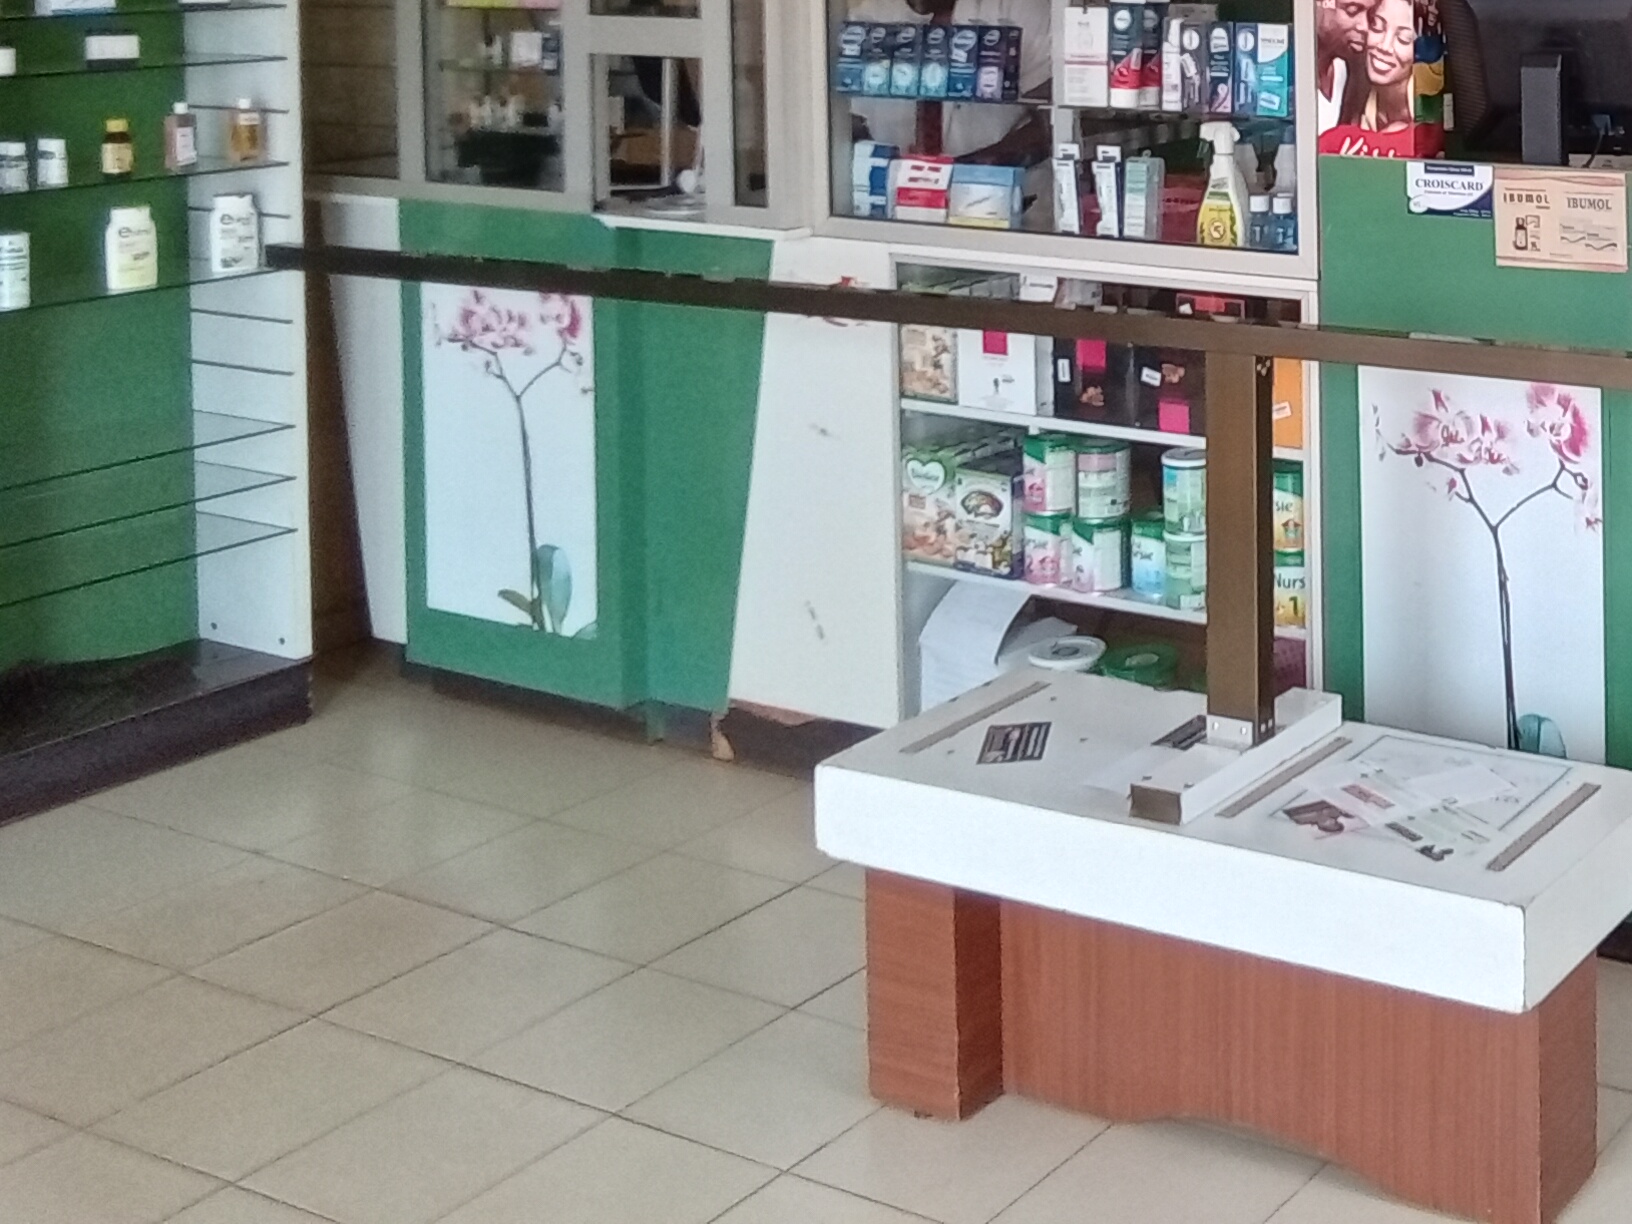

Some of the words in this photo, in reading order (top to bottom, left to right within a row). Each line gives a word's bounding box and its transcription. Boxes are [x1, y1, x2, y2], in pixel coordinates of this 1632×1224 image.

[1415, 178, 1484, 192] CROISCARD
[1567, 197, 1613, 210] IBUMOL
[1288, 596, 1300, 617] 1
